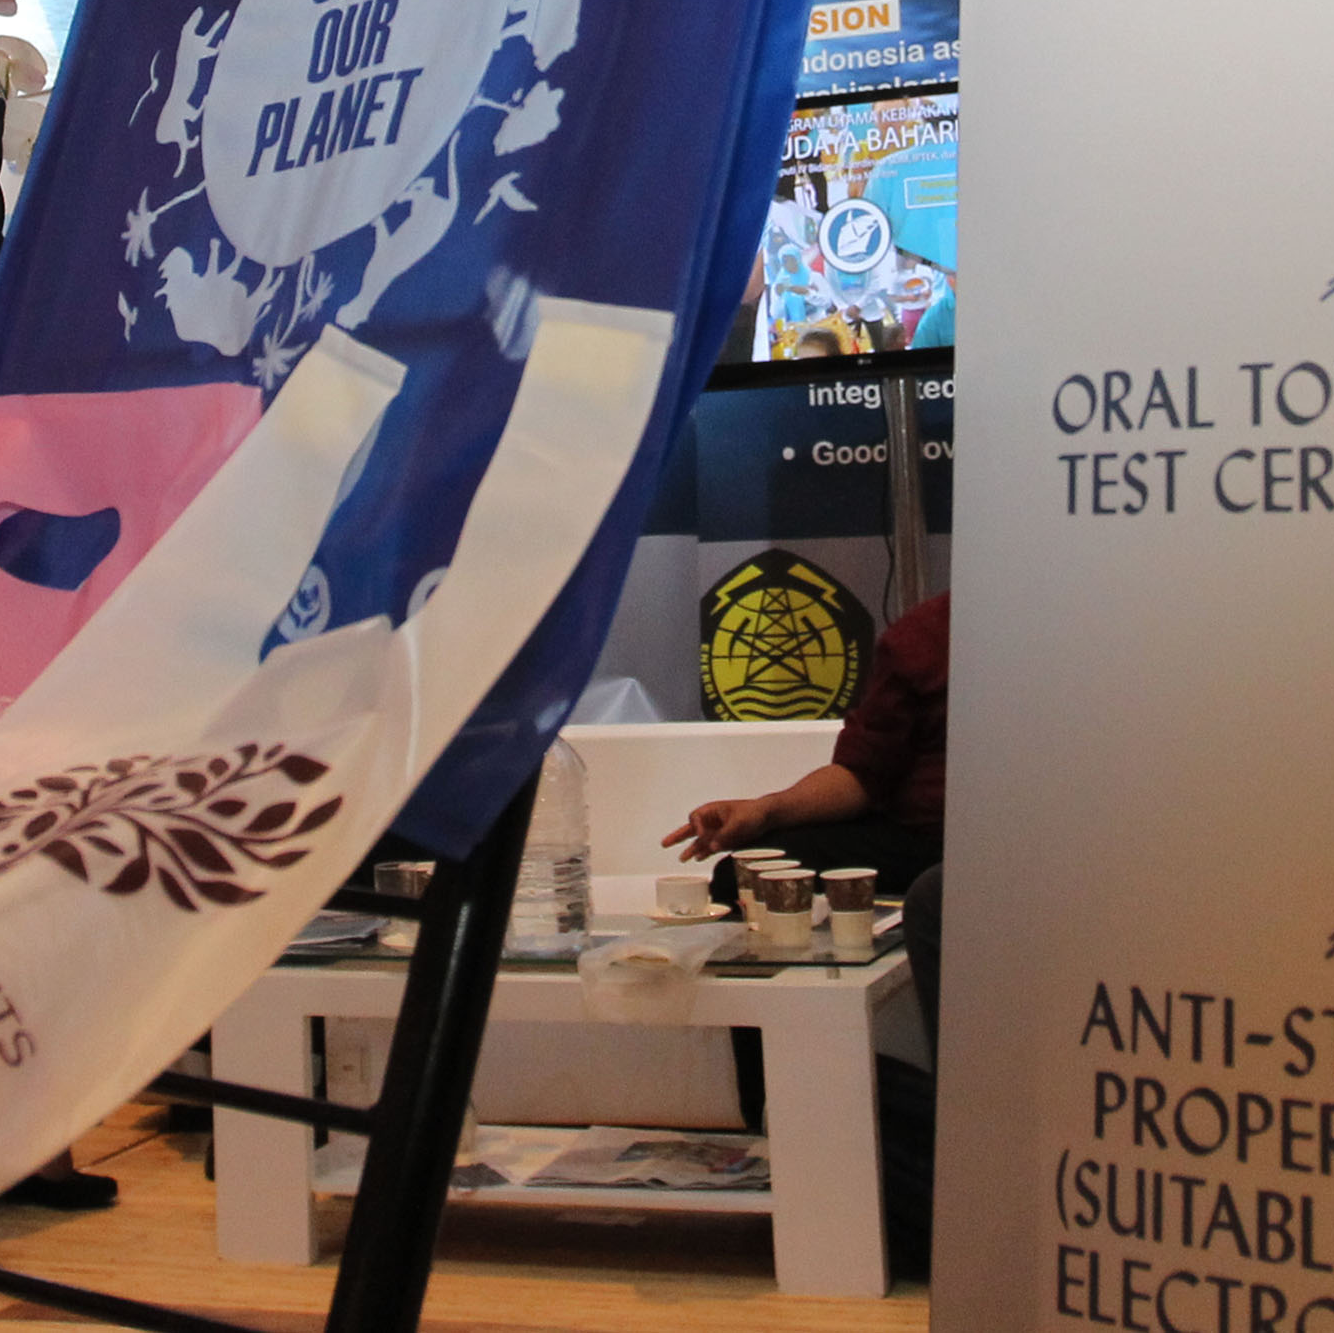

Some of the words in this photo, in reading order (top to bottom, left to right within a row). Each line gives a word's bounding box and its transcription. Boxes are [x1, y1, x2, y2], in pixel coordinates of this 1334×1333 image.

[809, 3, 891, 35] SION
[246, 68, 424, 179] PLANET
[1051, 366, 1215, 434] ORAL
[812, 438, 888, 466] Good
[1057, 450, 1188, 515] TEST
